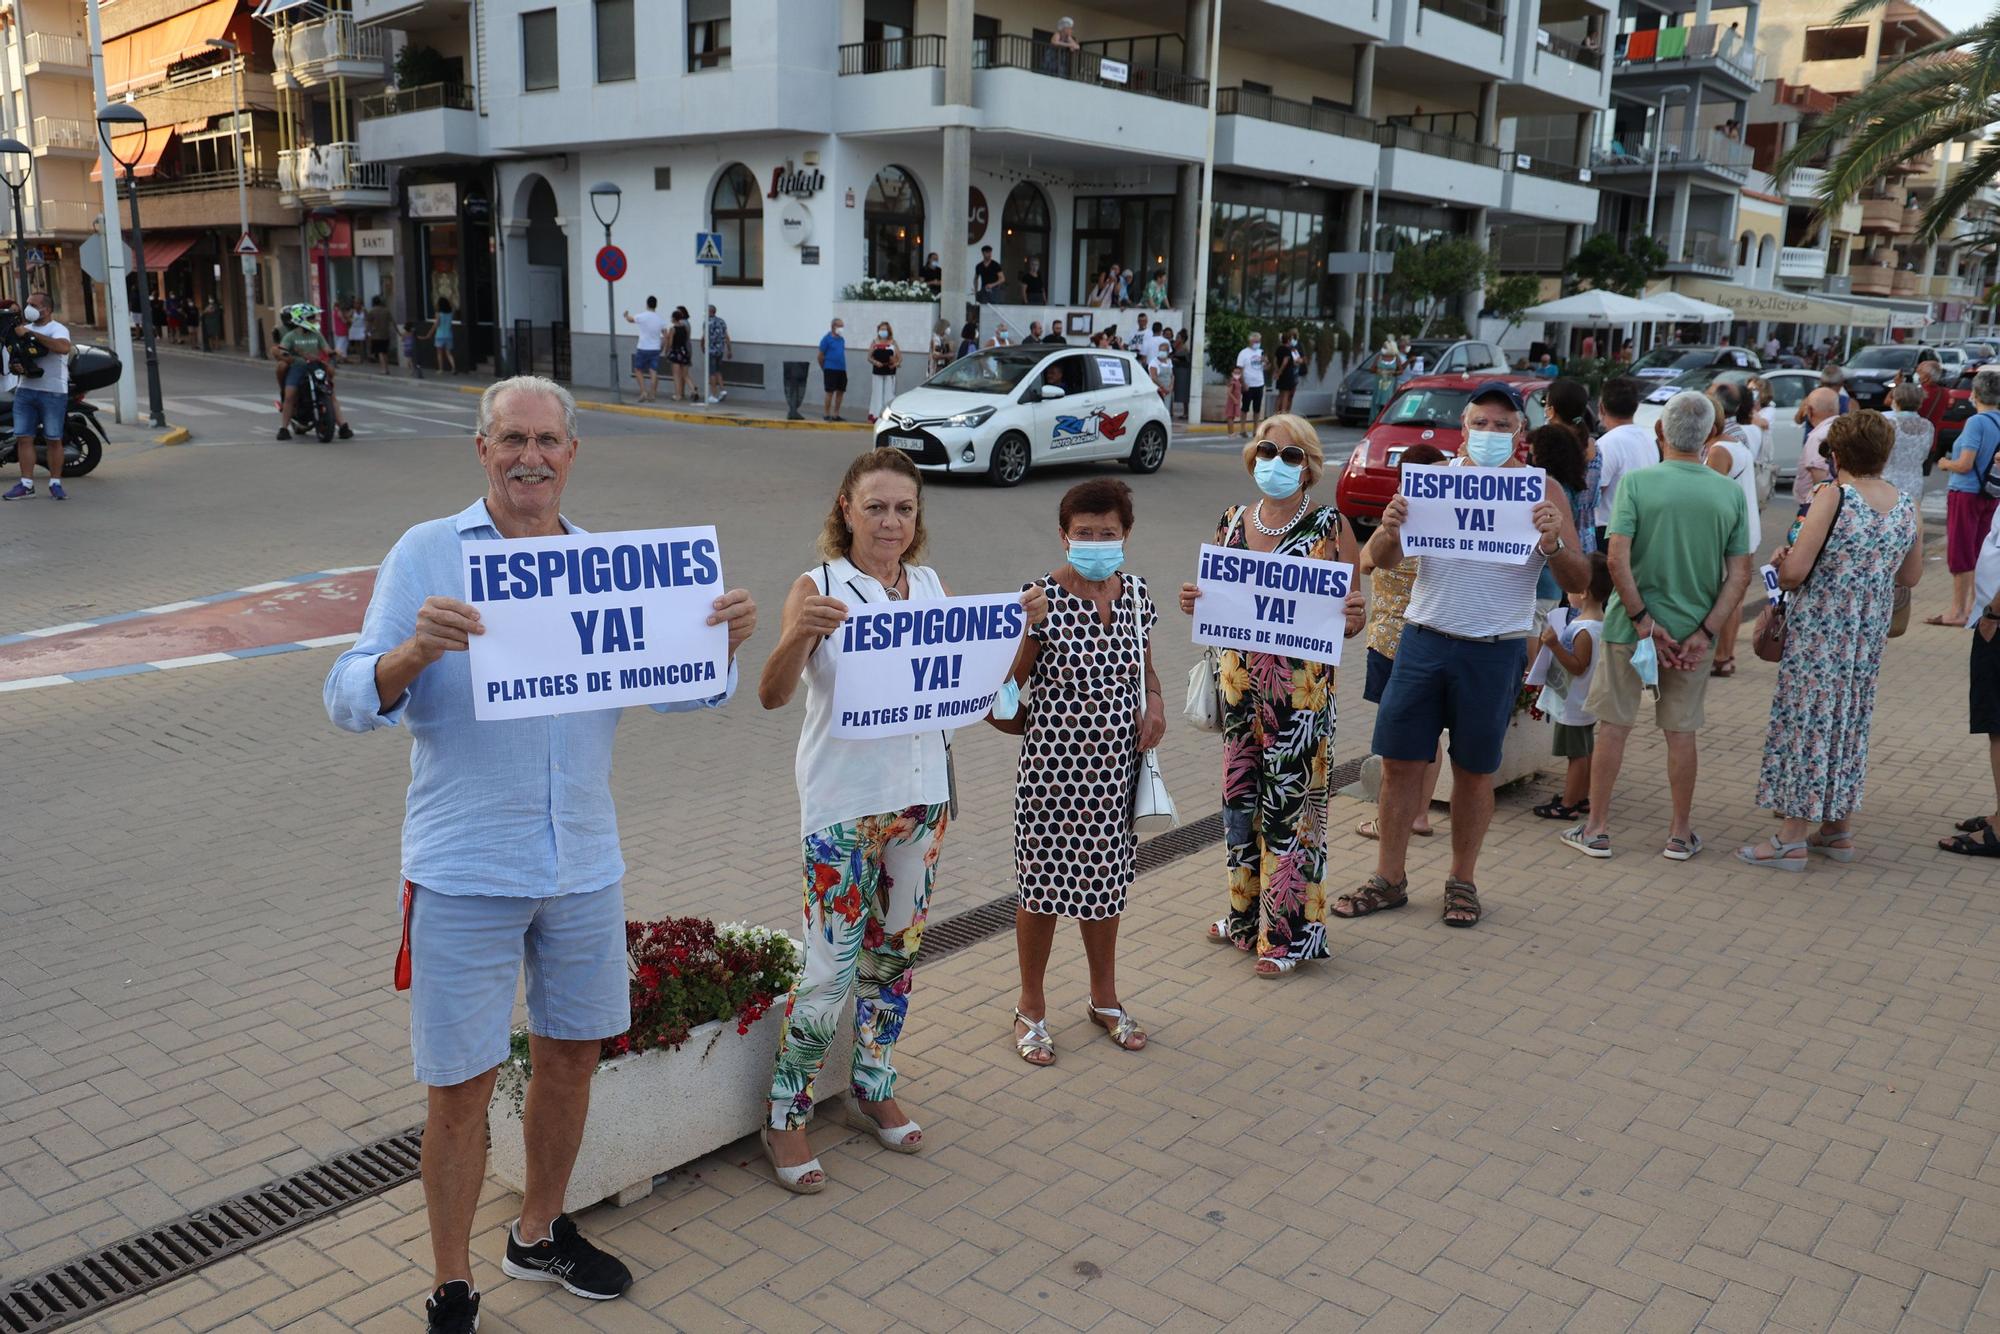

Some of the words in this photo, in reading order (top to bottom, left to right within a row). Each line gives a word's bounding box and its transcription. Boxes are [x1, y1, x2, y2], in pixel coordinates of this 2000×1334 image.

[1050, 437, 1071, 449] MOTO
[1403, 472, 1542, 502] ¡ESPIGONES
[1454, 507, 1495, 532] YA!
[1407, 536, 1455, 550] PLATGES
[1460, 539, 1474, 551] DE
[1478, 540, 1532, 556] MONCOFA
[469, 538, 719, 602] ¡ESPIGONES
[1200, 552, 1348, 598] ¡ESPIGONES
[1254, 594, 1296, 625] YA!
[570, 606, 645, 655] YA!
[842, 602, 1023, 652] ¡ESPIGONES
[1199, 623, 1252, 641] PLATGES
[1256, 630, 1271, 644] DE
[1275, 632, 1333, 654] MONCOFA
[487, 673, 579, 702] PLATGES
[586, 671, 612, 692] DE
[620, 661, 716, 690] MONCOFA
[910, 654, 963, 692] YA!
[841, 706, 908, 727] PLATGES
[914, 703, 932, 720] DE
